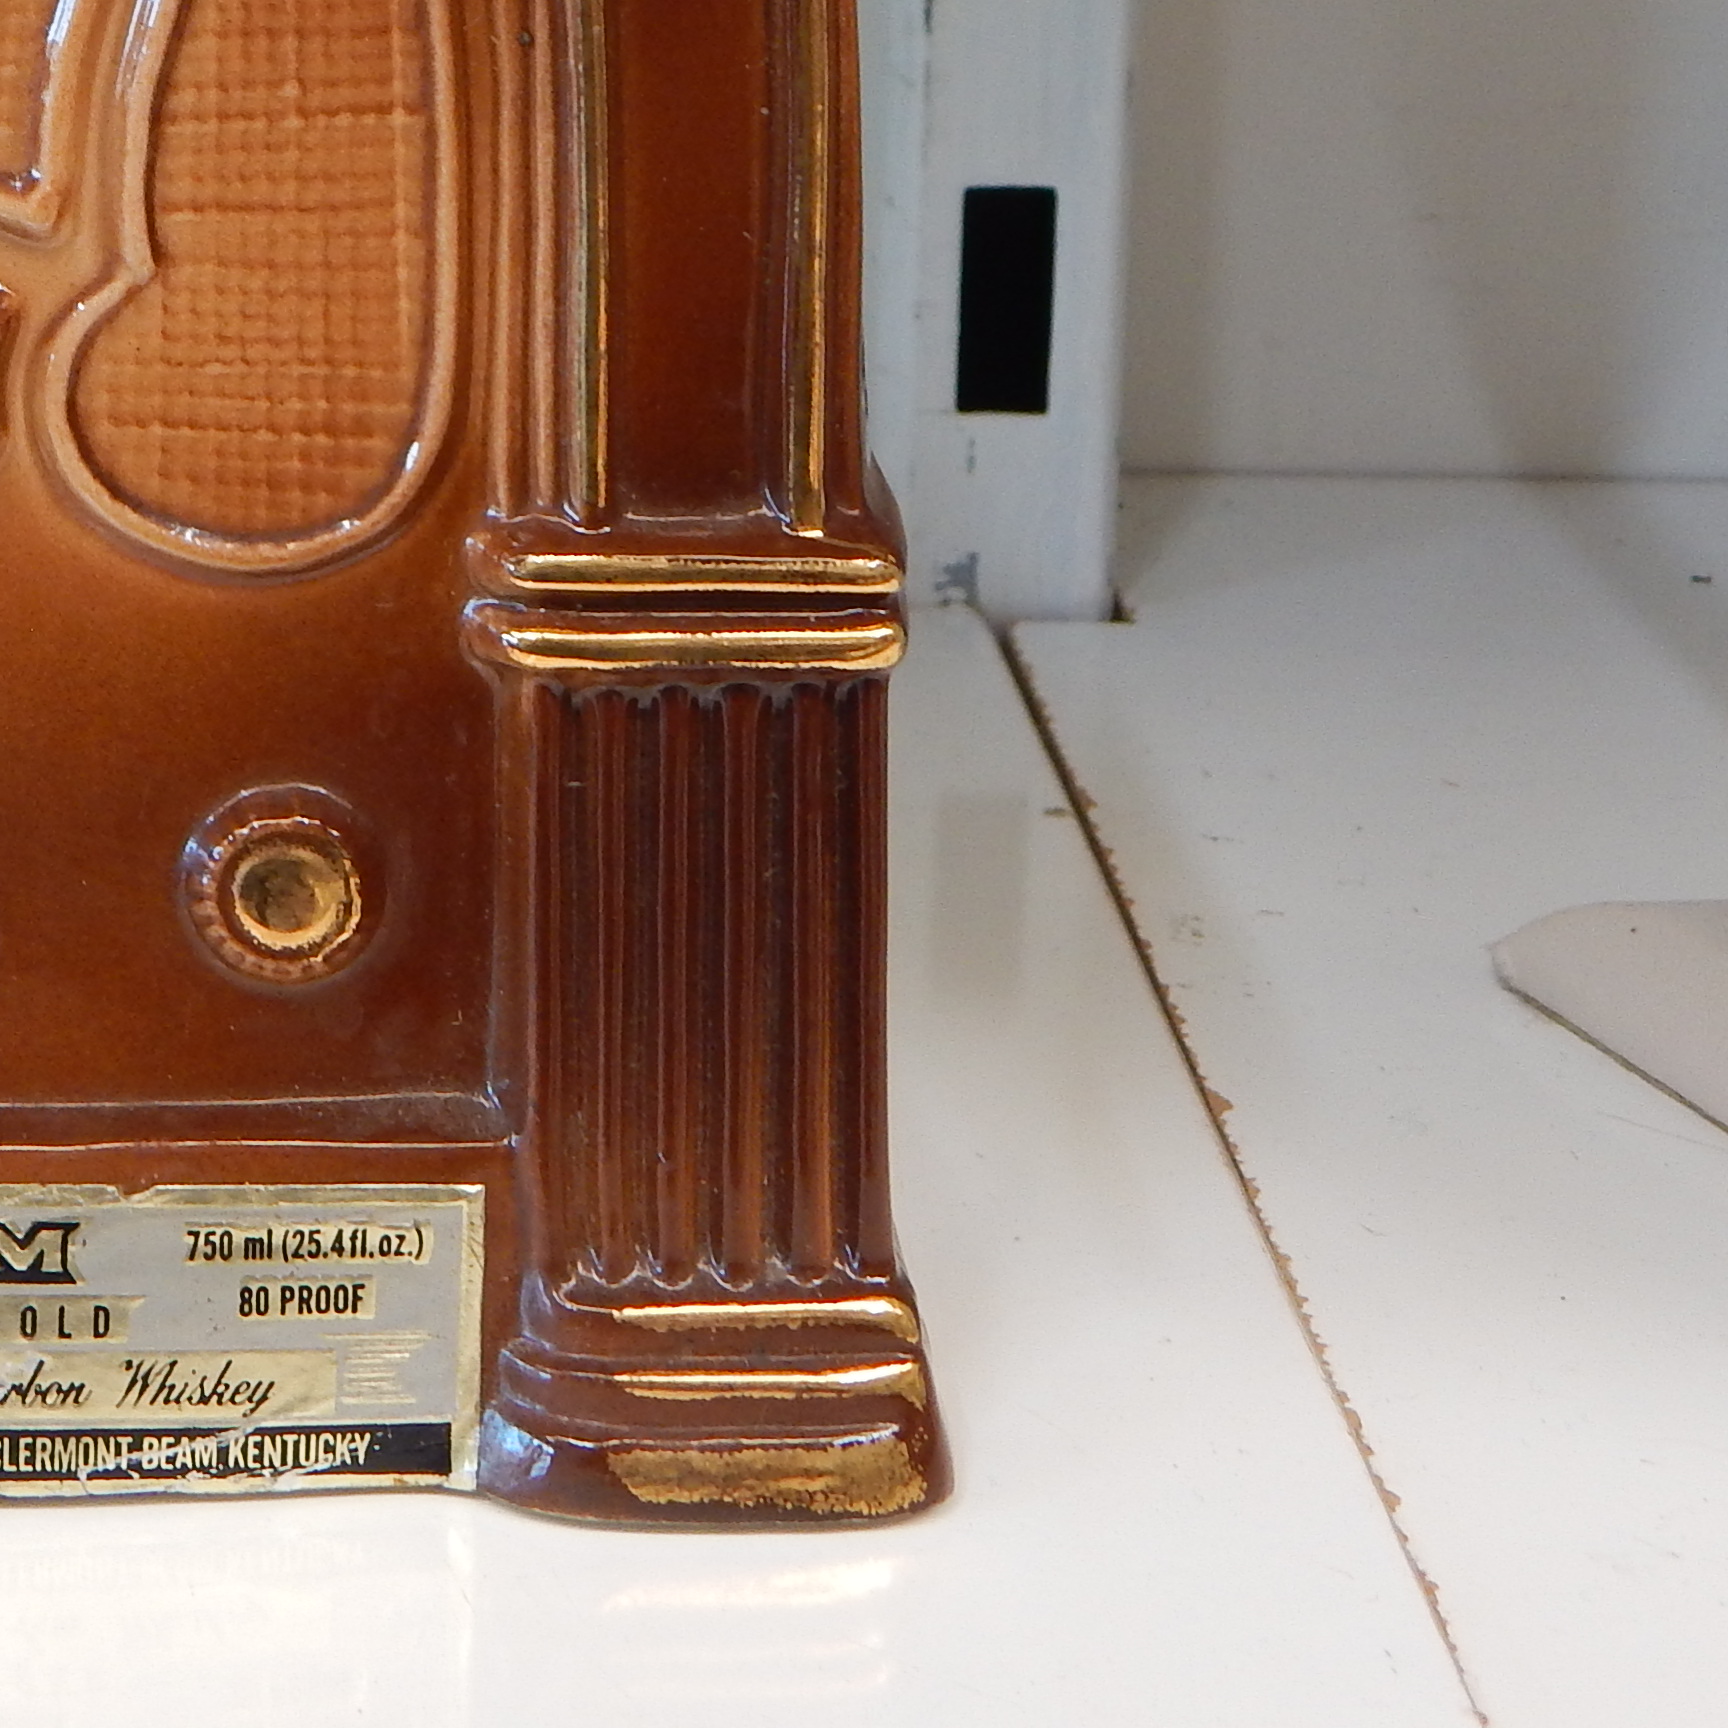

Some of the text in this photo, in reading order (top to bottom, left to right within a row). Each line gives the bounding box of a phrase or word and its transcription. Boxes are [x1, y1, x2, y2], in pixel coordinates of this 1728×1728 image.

[186, 1229, 234, 1261] 750
[243, 1228, 273, 1261] ml
[238, 1283, 366, 1317] 80 PROOF
[18, 1304, 111, 1340] OLD
[115, 1358, 276, 1418] Whiskey
[228, 1432, 371, 1470] KENTUCKY
